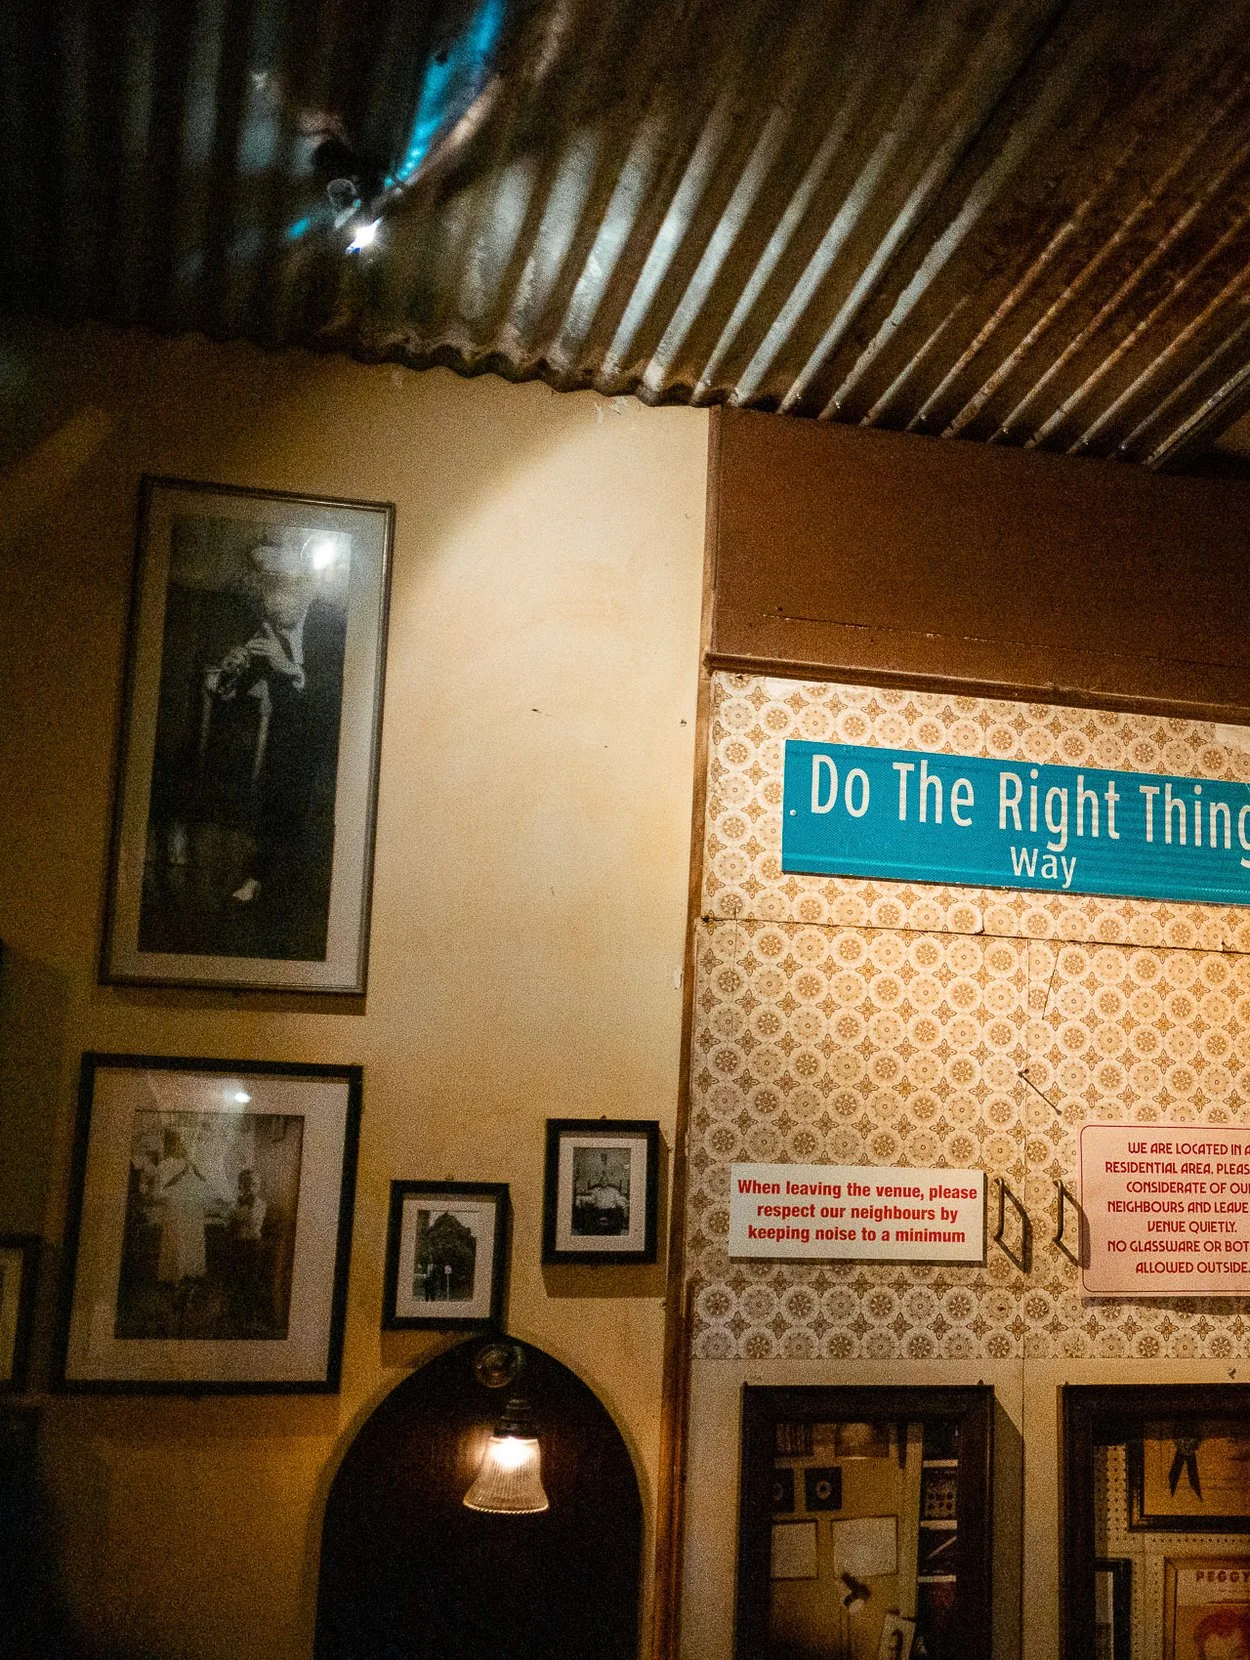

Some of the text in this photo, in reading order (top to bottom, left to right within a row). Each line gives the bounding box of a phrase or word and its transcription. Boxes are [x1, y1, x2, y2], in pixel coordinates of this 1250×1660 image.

[811, 754, 870, 818] Do
[892, 760, 975, 827] The
[998, 769, 1120, 853] Right
[1010, 846, 1077, 889] Way
[1128, 1142, 1147, 1154] WE
[1150, 1143, 1173, 1154] ARE
[1176, 1143, 1228, 1155] LOCATED
[1231, 1144, 1243, 1155] IN
[1105, 1162, 1178, 1174] RESIDENTIAL
[737, 1179, 978, 1201] When leaving the venue, please
[1126, 1181, 1207, 1194] CONSIDERATE
[1209, 1182, 1227, 1194] OF
[757, 1204, 959, 1224] respect our neighbours by
[1107, 1201, 1185, 1213] NEIGHBOURS
[1187, 1202, 1211, 1213] AND
[1214, 1202, 1249, 1214] LEAVE
[748, 1225, 966, 1243] keeping noise to a minimum
[1147, 1221, 1237, 1234] VENUE QUIETLY.
[1107, 1240, 1127, 1252] NO
[1129, 1240, 1200, 1252] GLASSWARE
[1203, 1241, 1222, 1252] OR
[1135, 1261, 1250, 1274] ALLOWED OUTSIDE.
[1195, 1570, 1250, 1583] PEGGY
